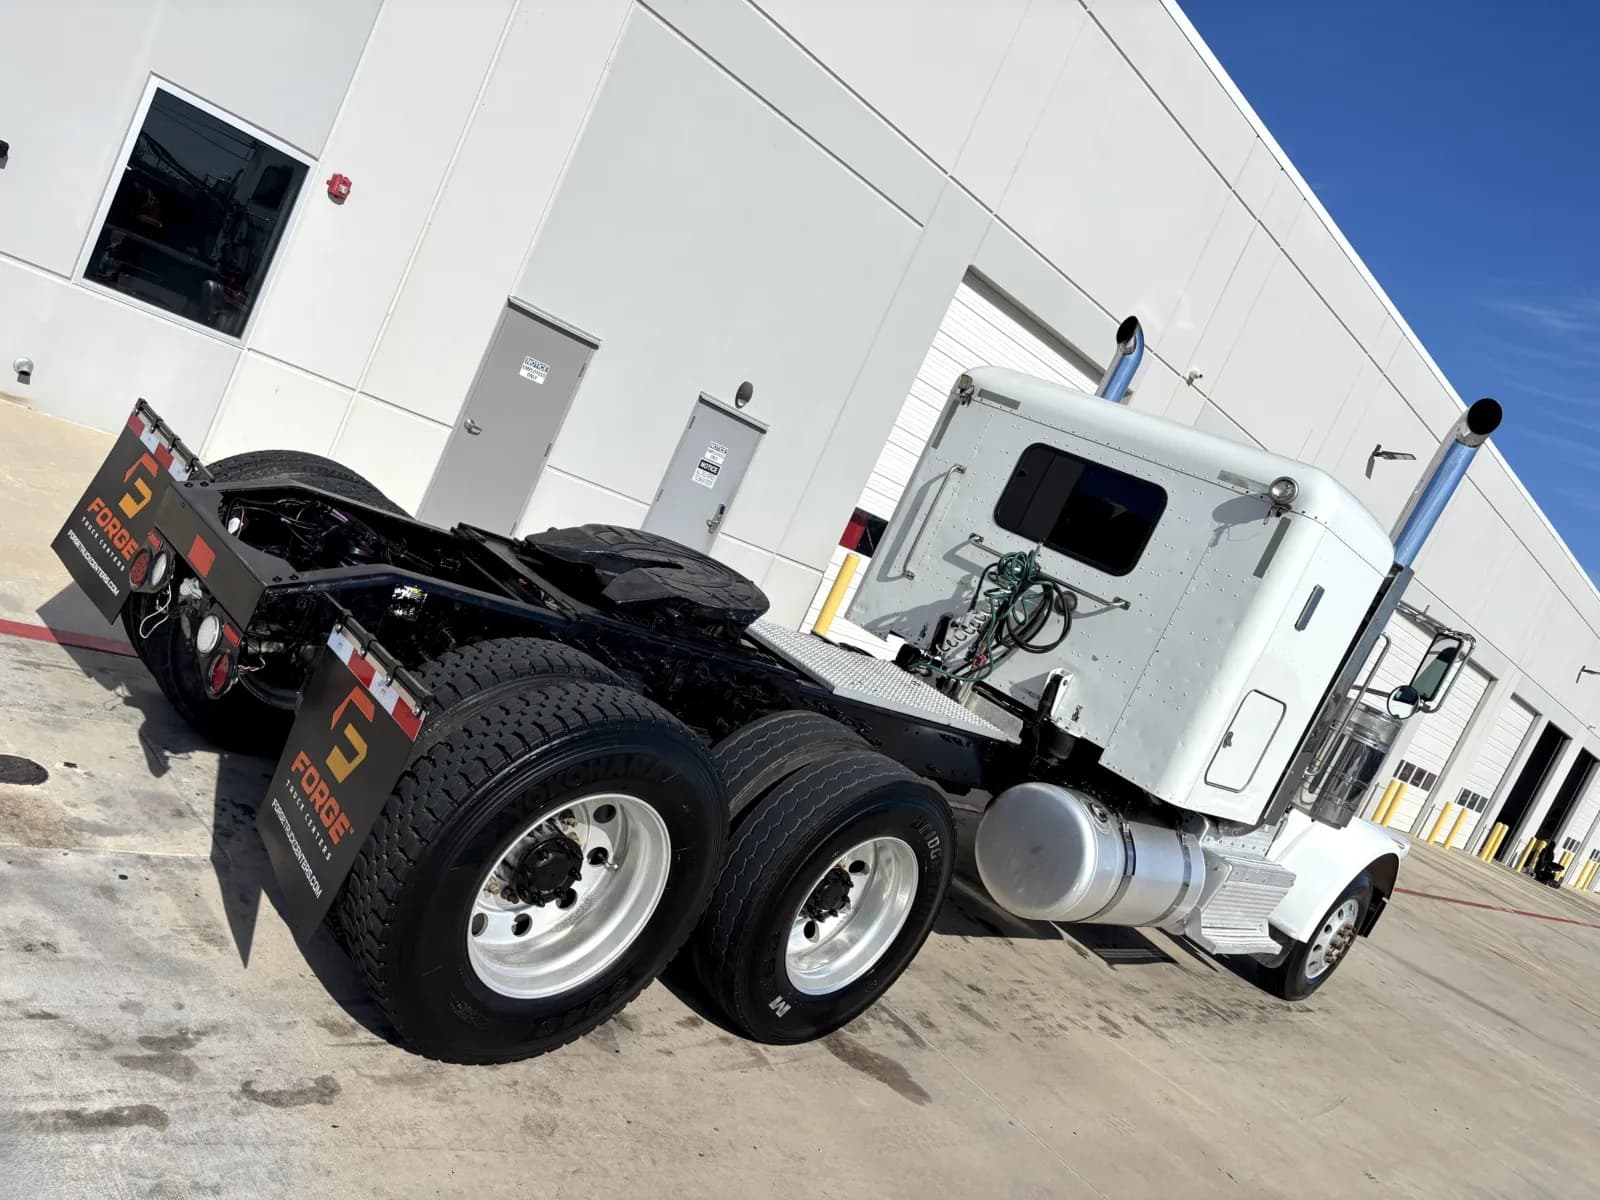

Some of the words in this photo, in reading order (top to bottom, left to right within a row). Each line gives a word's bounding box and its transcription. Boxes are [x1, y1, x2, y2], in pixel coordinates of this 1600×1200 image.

[700, 461, 719, 474] NOTICE
[87, 497, 140, 561] FORGE
[99, 539, 125, 572] CENTERS
[286, 779, 305, 812] TRUCK
[304, 812, 332, 861] CENTERS
[290, 750, 350, 845] FORGE
[271, 798, 323, 899] FORGETRUCKCENTERS.COM
